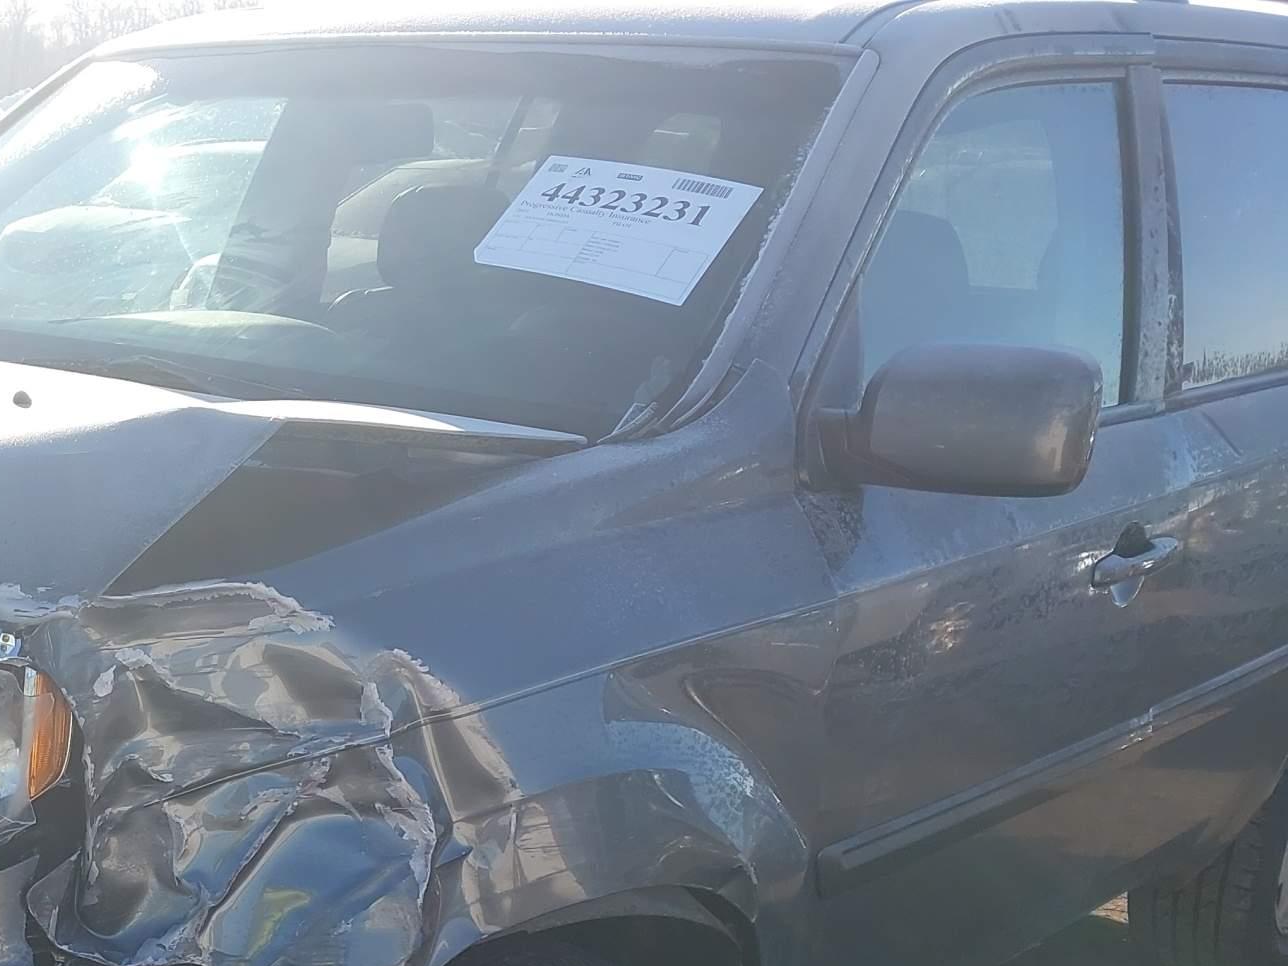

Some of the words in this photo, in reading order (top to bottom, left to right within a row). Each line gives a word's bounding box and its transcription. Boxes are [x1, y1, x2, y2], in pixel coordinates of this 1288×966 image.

[520, 200, 569, 212] Progressive
[570, 206, 605, 218] Casualty
[608, 211, 652, 225] Insurance
[540, 182, 712, 227] 44323231
